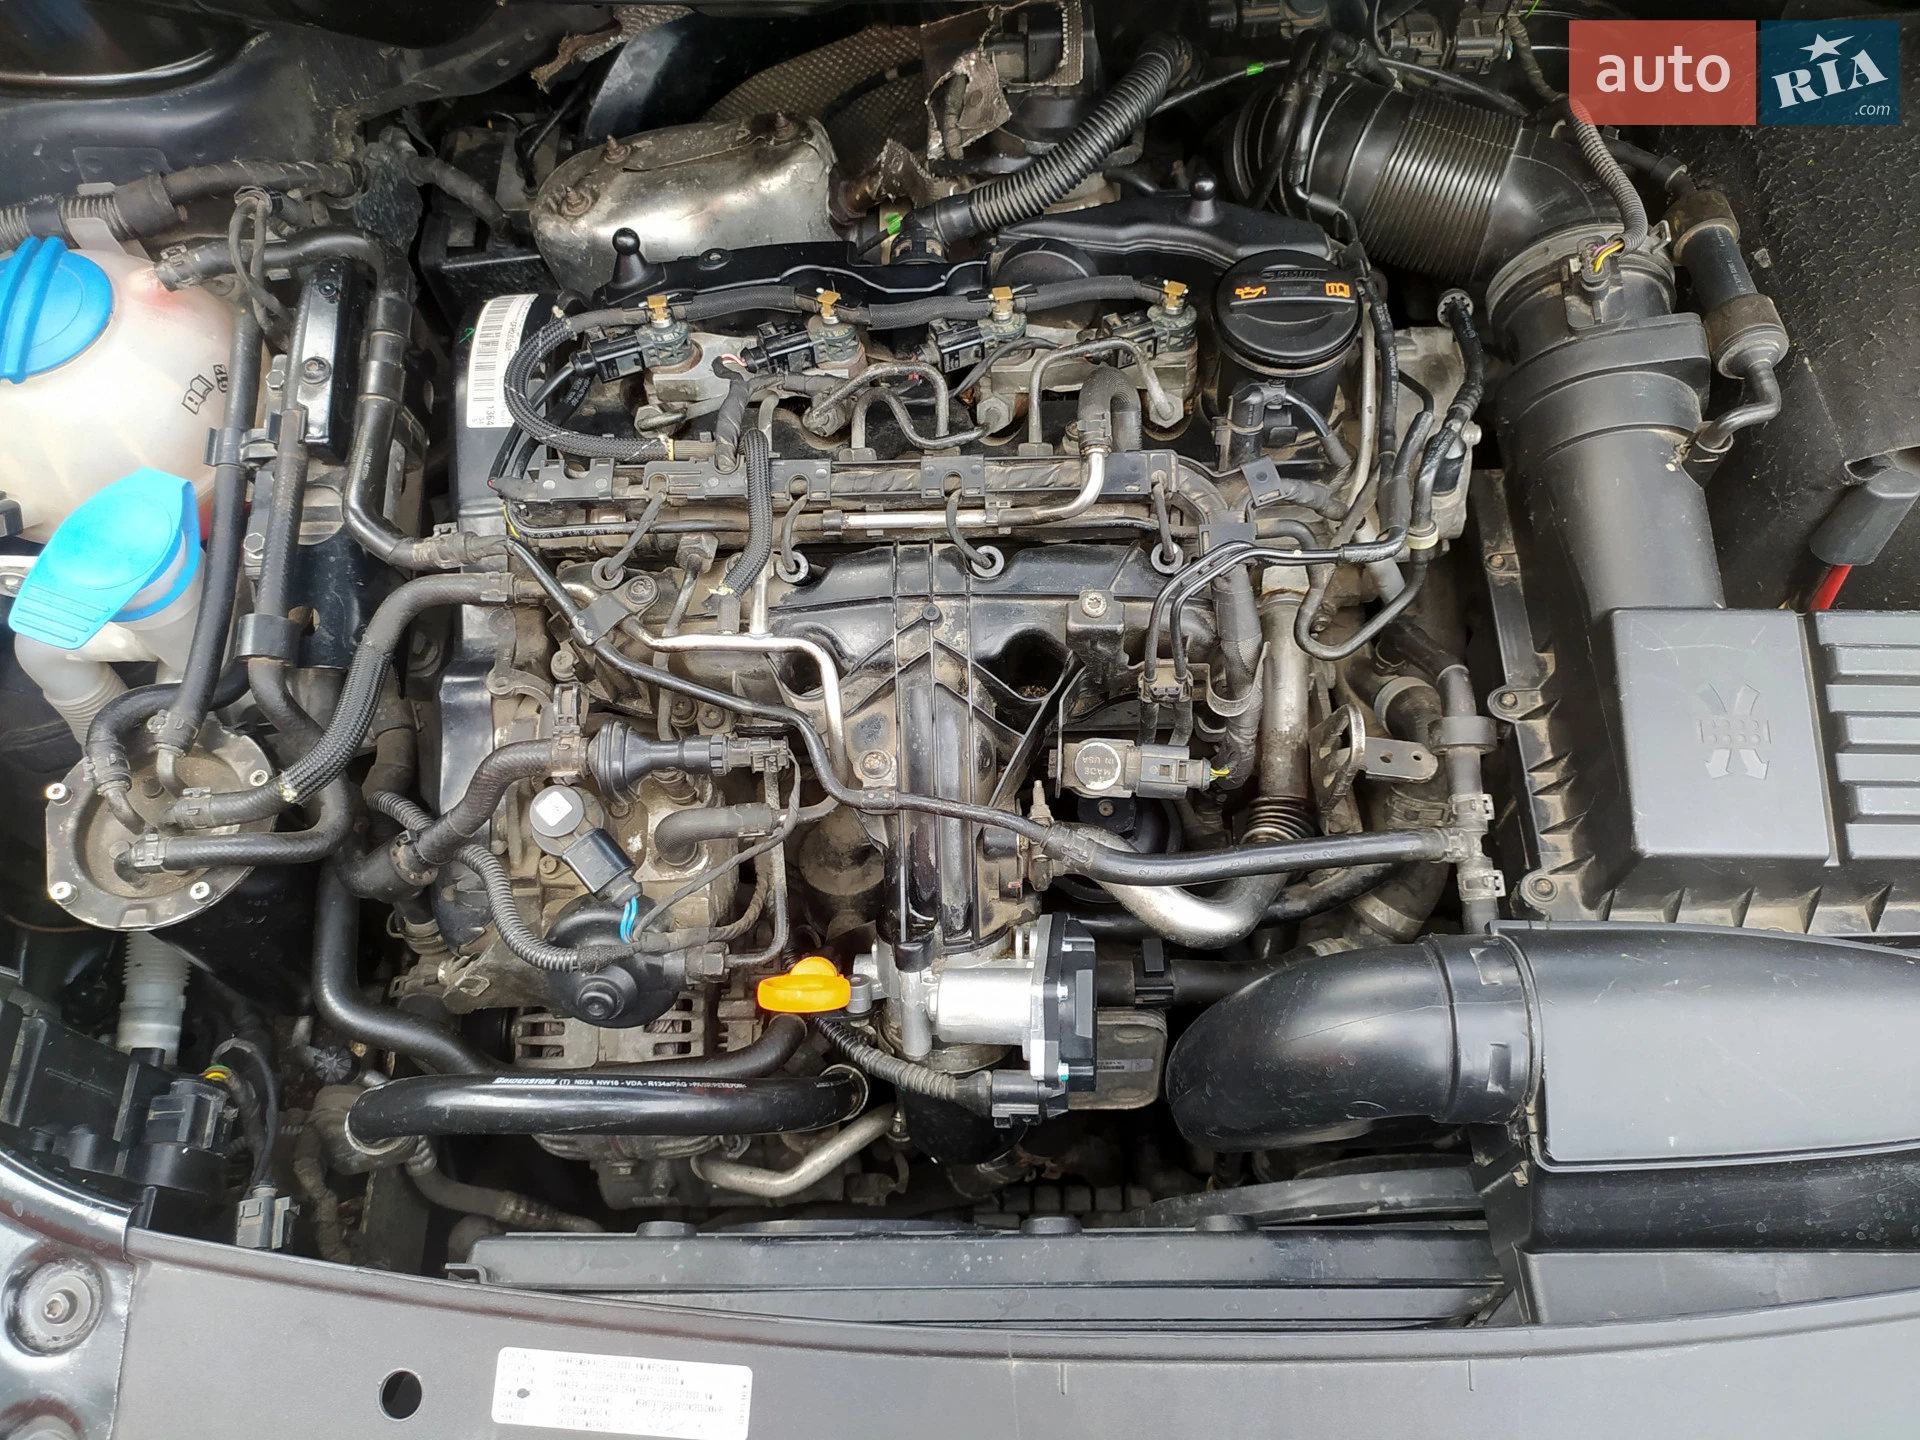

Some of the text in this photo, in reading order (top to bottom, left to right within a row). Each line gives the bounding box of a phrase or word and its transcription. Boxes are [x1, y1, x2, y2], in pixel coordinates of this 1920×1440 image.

[214, 364, 228, 391] G12
[1081, 756, 1114, 765] IN USA
[1084, 766, 1111, 775] MADE
